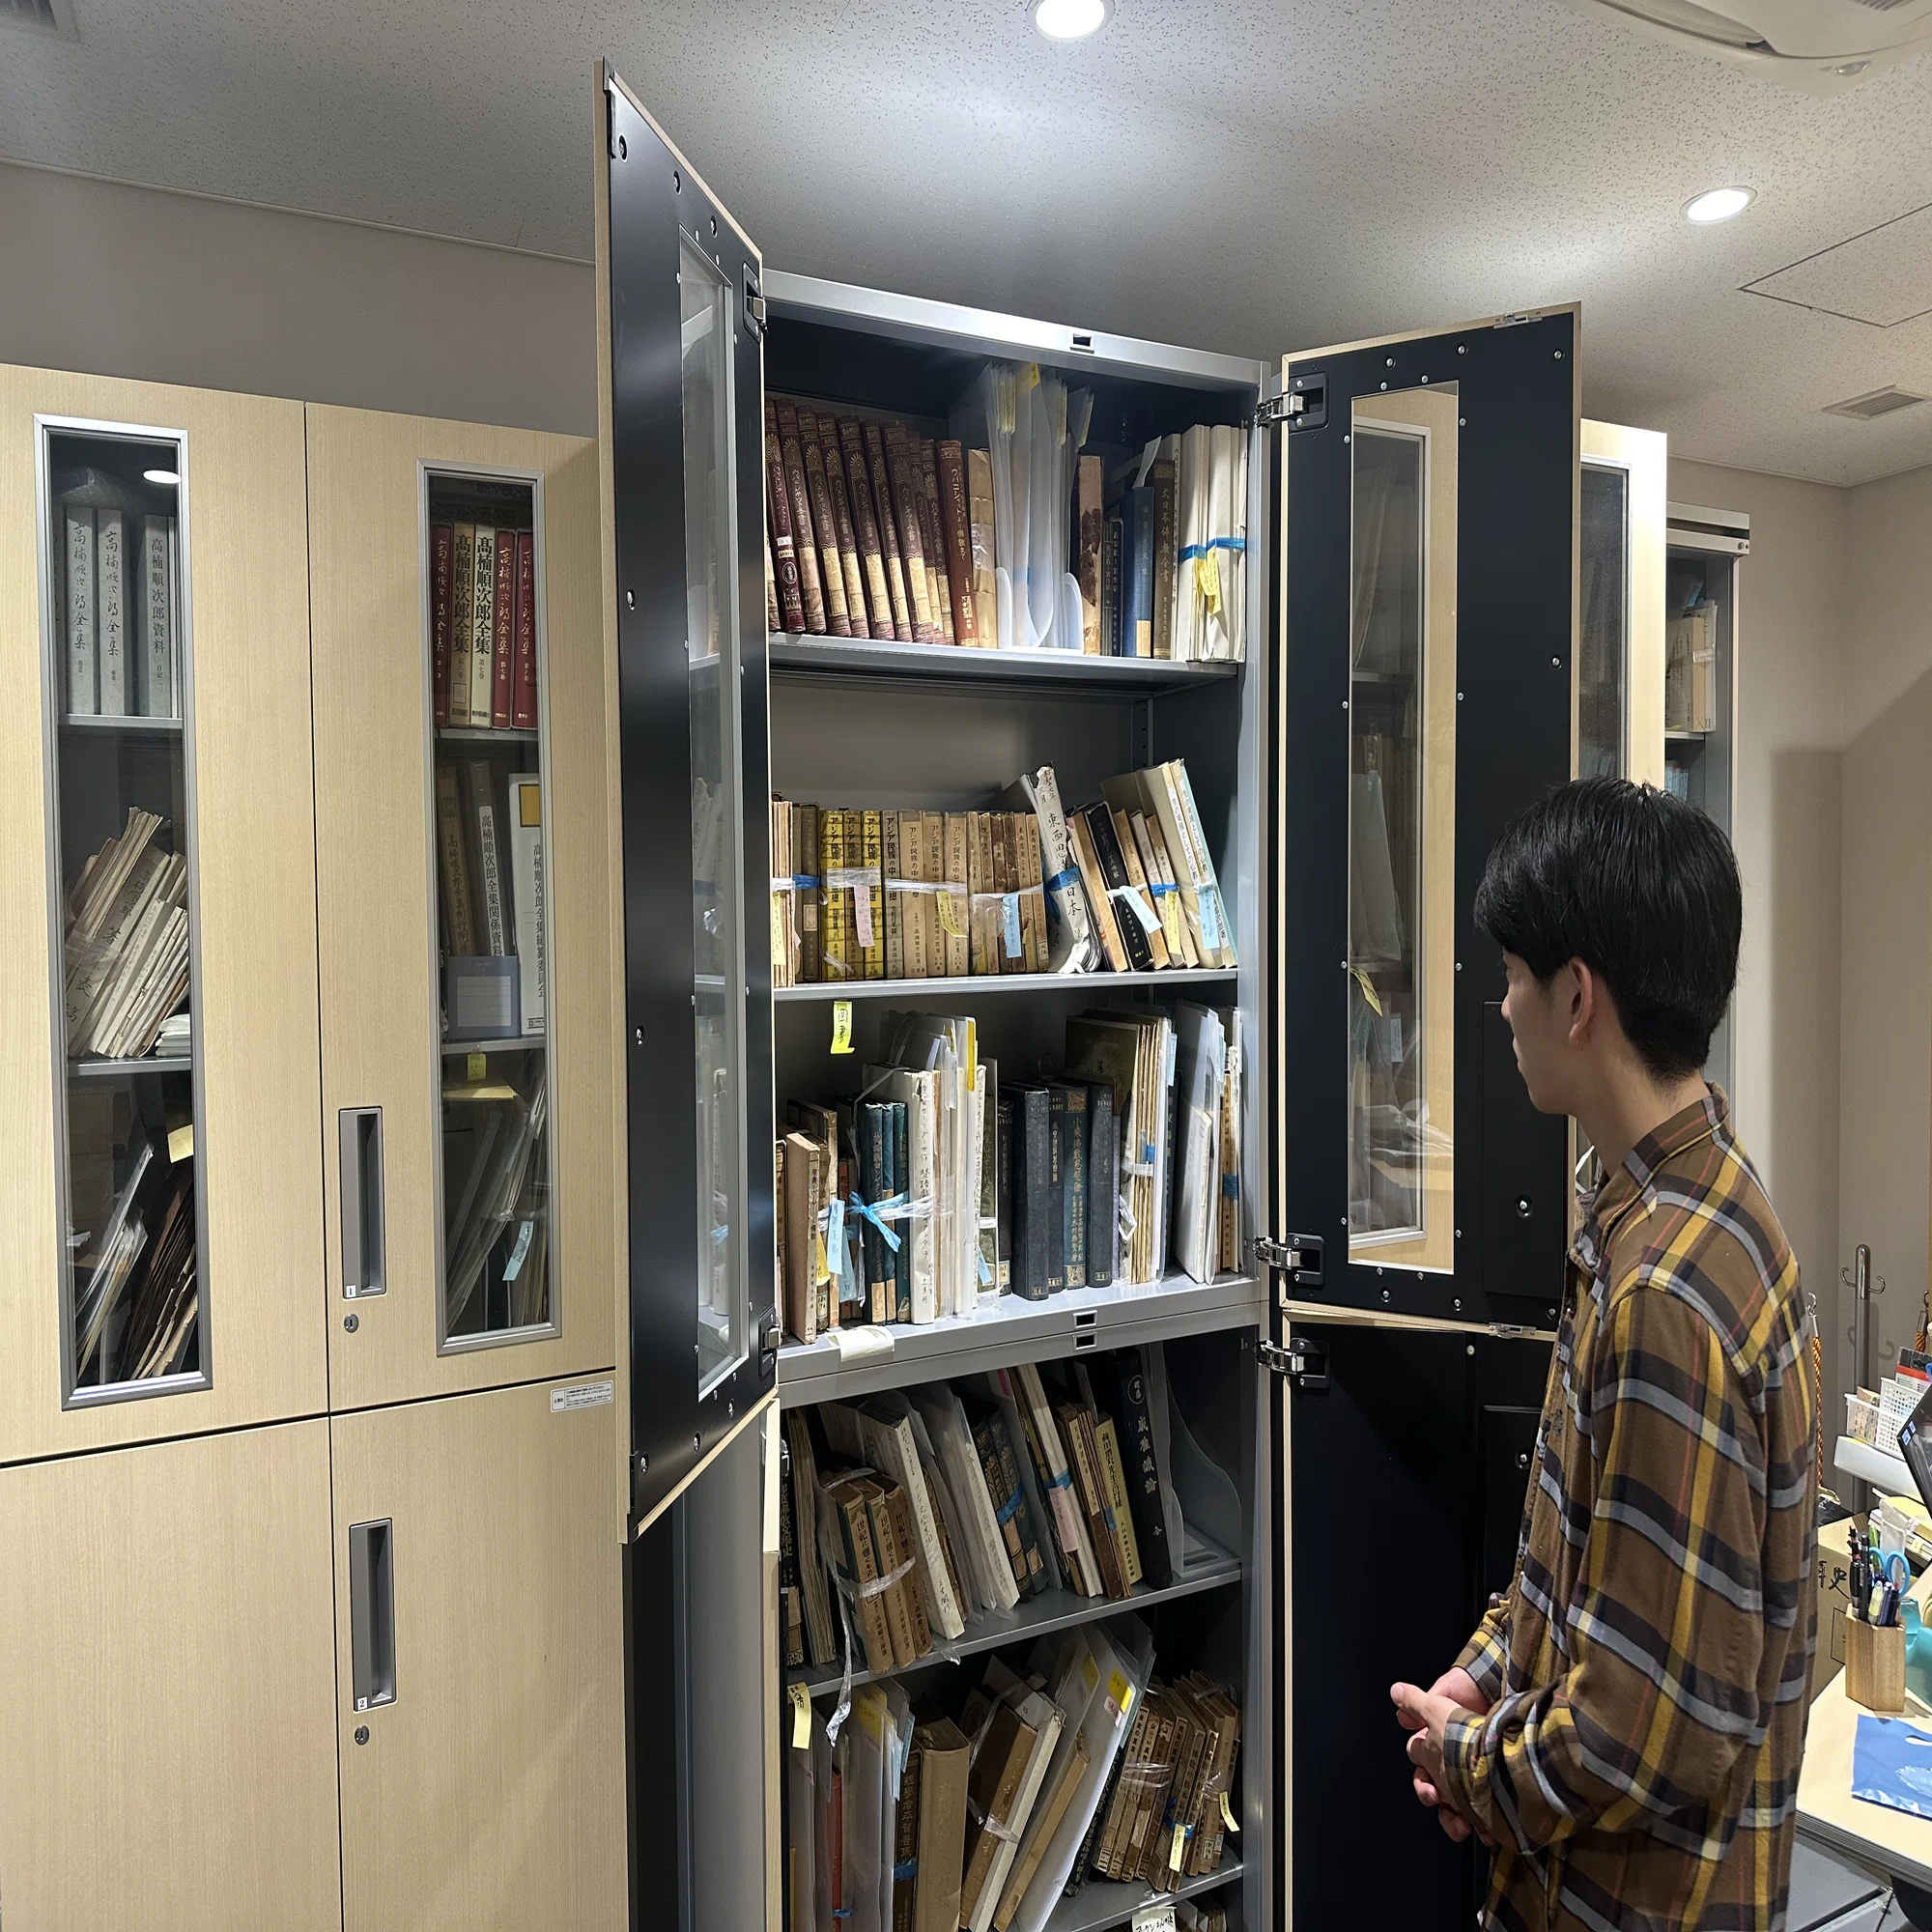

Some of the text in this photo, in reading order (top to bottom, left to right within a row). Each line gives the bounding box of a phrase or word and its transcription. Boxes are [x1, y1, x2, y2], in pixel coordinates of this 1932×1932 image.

[151, 537, 166, 655] 高楠順次郎資料
[830, 817, 840, 903] アジア民族の思想
[886, 817, 897, 902] アジア民族の中想
[909, 827, 920, 897] アジア民族の中想
